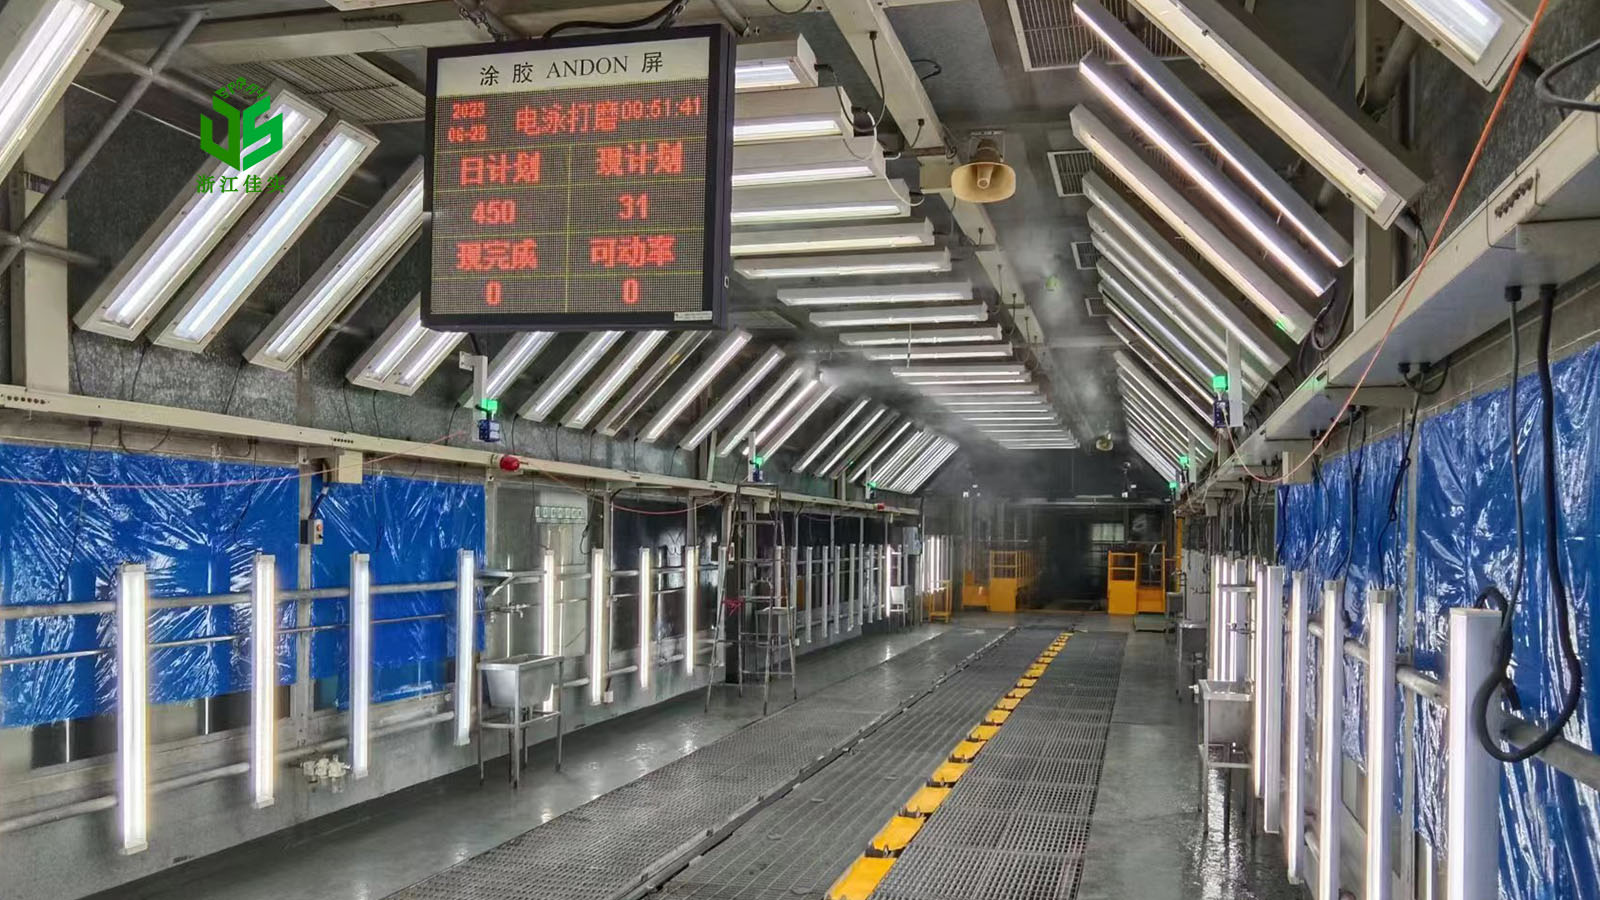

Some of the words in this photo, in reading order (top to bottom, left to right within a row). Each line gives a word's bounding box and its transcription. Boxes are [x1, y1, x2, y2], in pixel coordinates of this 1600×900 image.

[480, 62, 534, 86] 涂胶
[546, 56, 628, 79] ANDON
[641, 51, 663, 74] 屏
[452, 101, 485, 119] 2023
[516, 101, 619, 135] 电泳打磨
[621, 95, 702, 119] 09:51:41
[460, 151, 541, 186] 日计划
[596, 141, 684, 176] 现计划
[471, 198, 517, 225] 450
[617, 192, 648, 220] 31
[456, 237, 538, 271] 现完成
[590, 234, 676, 267] 可动率
[485, 280, 502, 306] 0
[621, 278, 640, 304] 0
